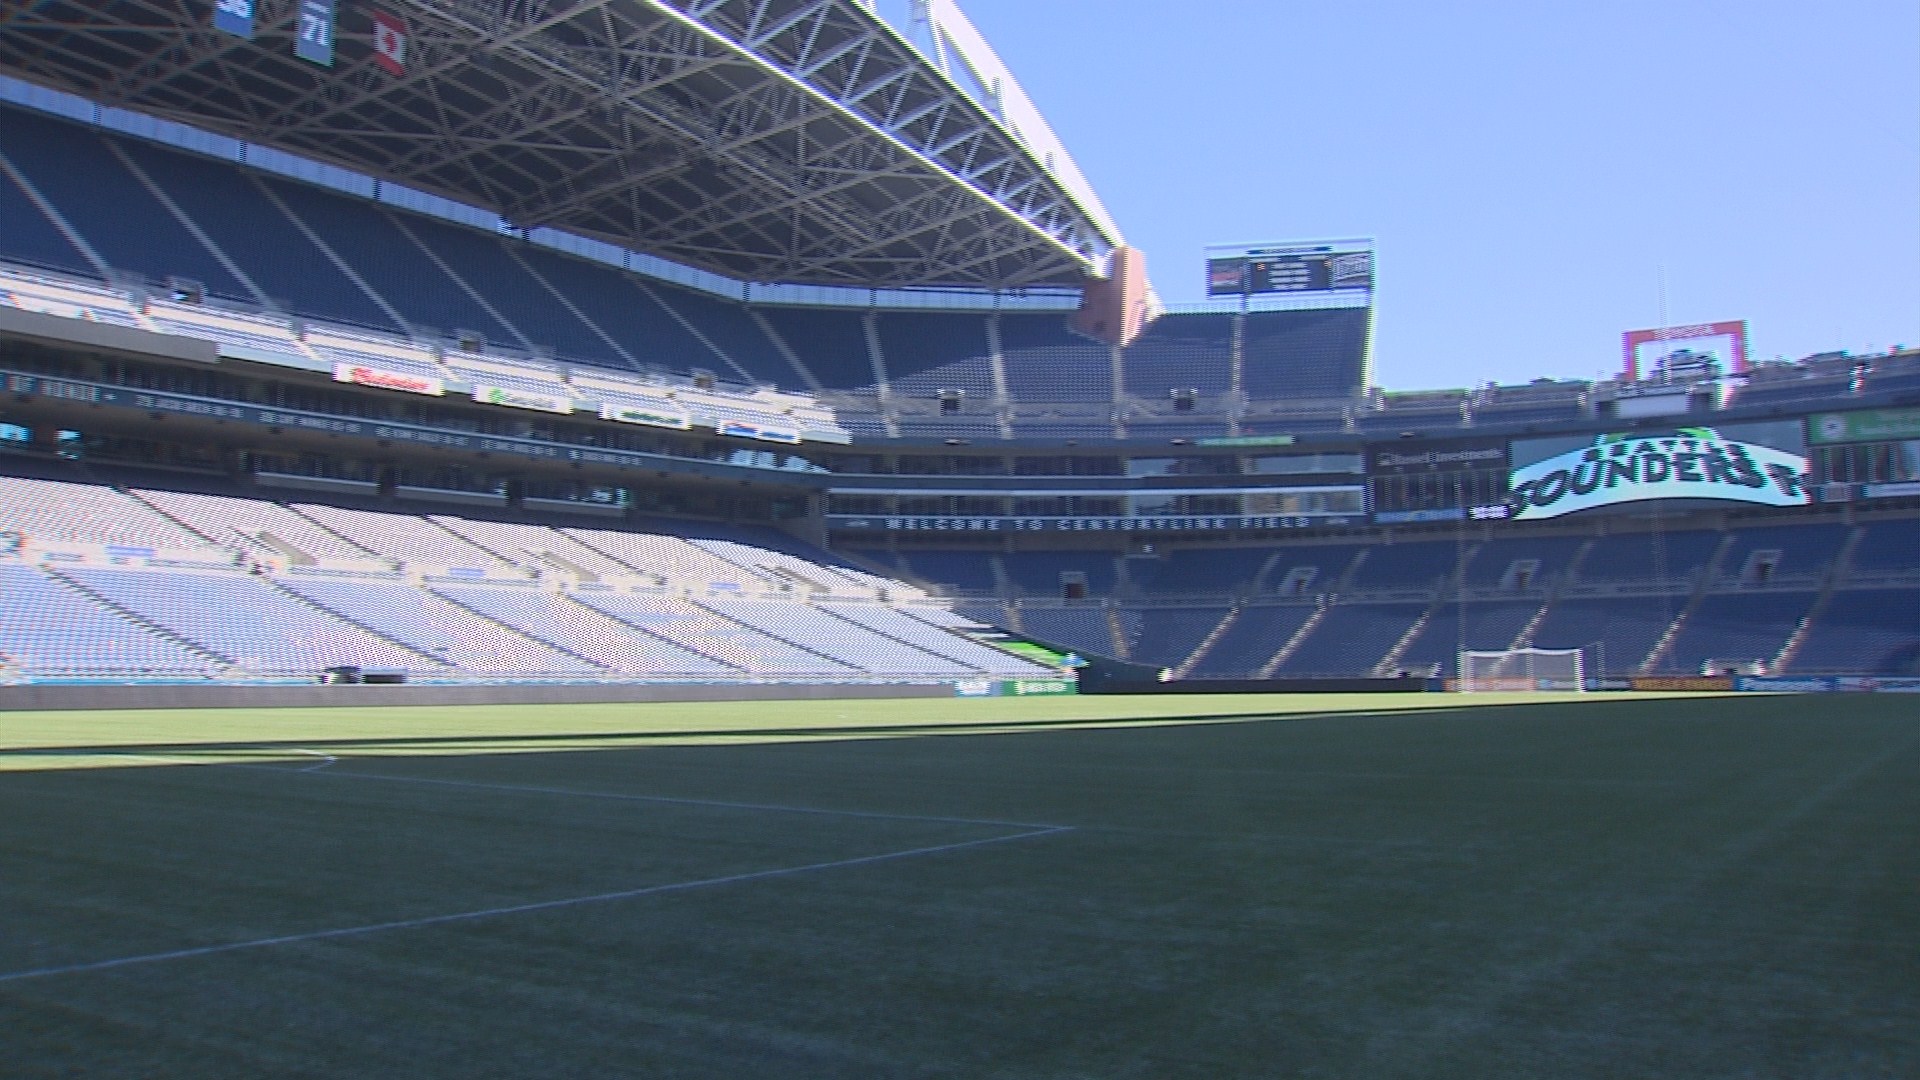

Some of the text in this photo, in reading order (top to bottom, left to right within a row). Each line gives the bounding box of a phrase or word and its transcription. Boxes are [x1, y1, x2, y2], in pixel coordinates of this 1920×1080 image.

[301, 15, 329, 46] 71
[1582, 438, 1748, 462] SEATTLE
[1511, 452, 1768, 517] SOUNDERS
[884, 516, 1310, 530] WELCOME TO CENTURYLINK FIELD
